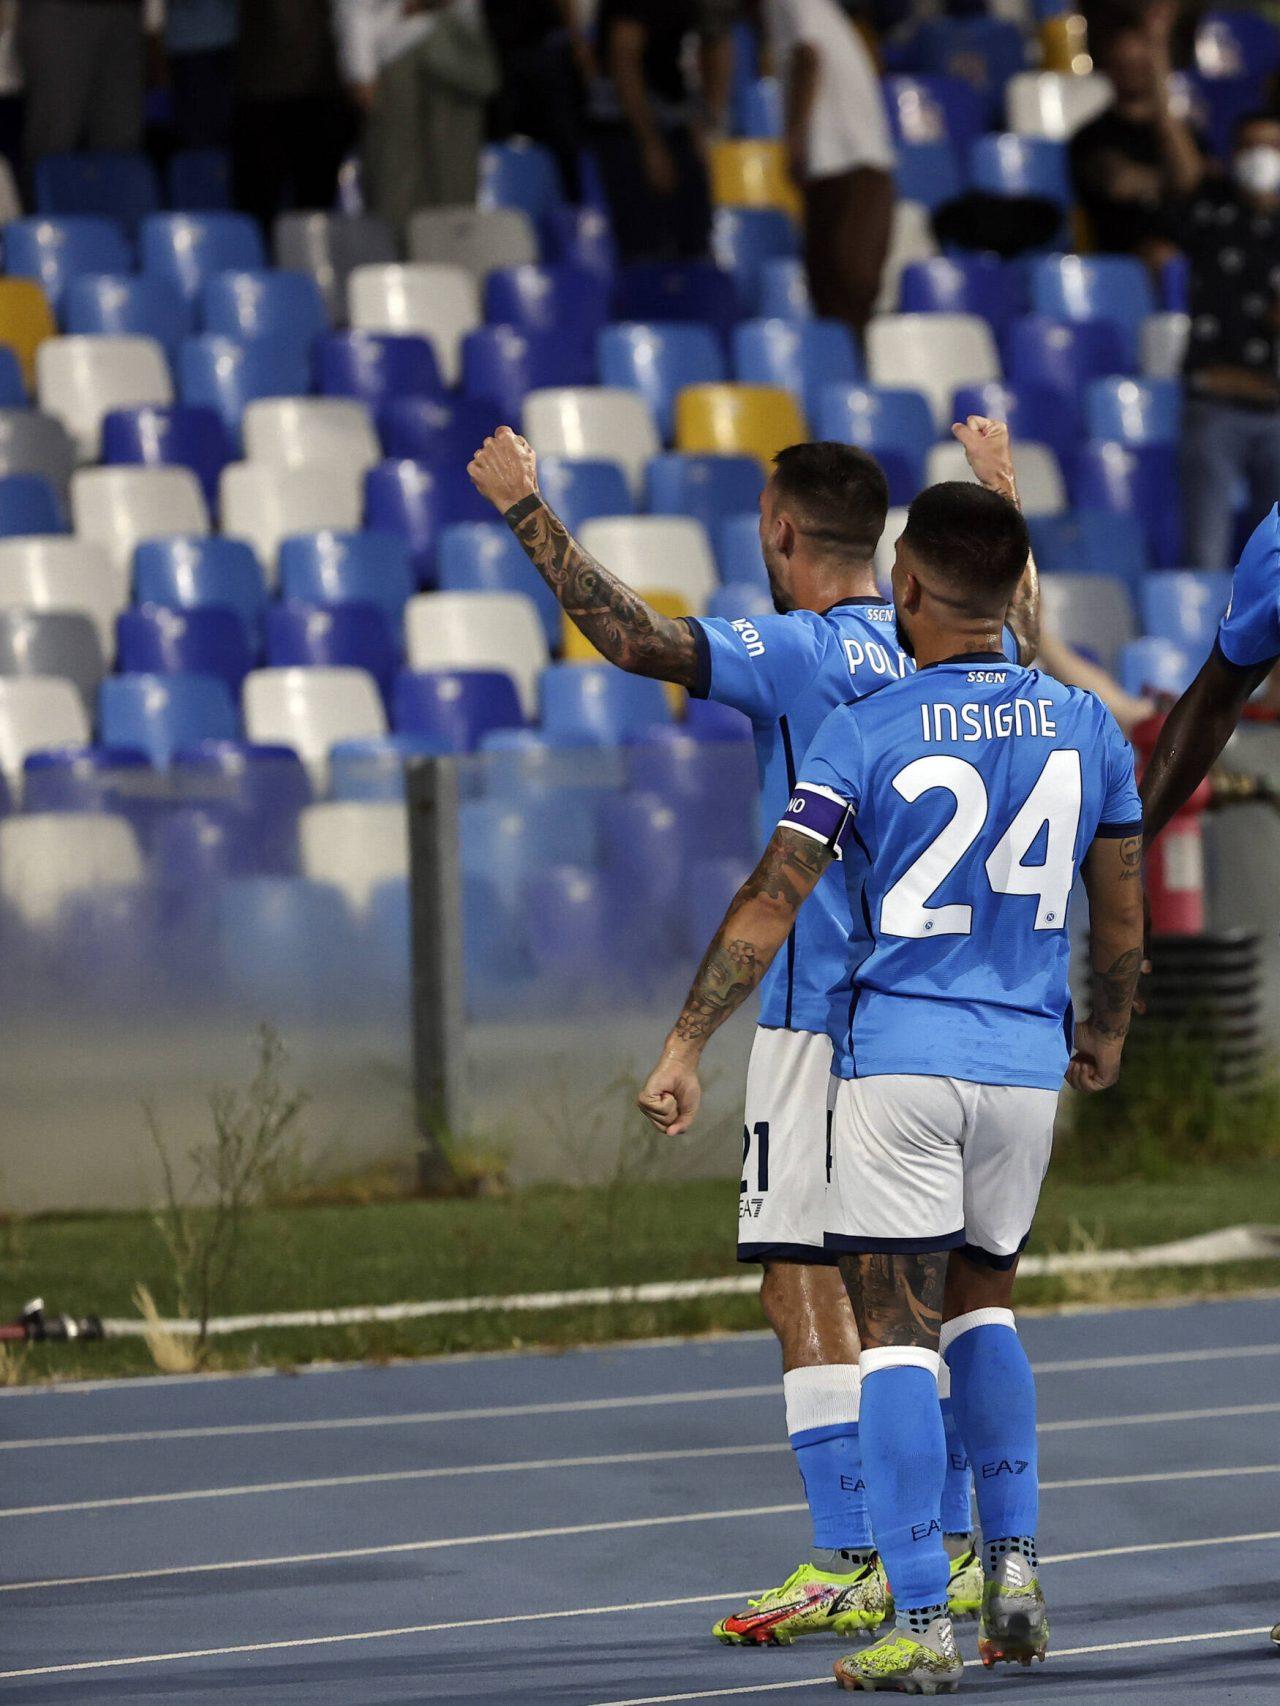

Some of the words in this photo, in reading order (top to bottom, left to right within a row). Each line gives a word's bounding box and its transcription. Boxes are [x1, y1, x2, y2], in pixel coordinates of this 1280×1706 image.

[867, 608, 894, 622] SSCN
[967, 671, 1006, 684] SSCN
[921, 698, 1057, 742] INSIGNE
[785, 797, 806, 813] NO
[879, 748, 1082, 939] 24
[982, 1459, 1029, 1479] EA7
[841, 1475, 866, 1492] EA
[911, 1518, 941, 1541] EA
